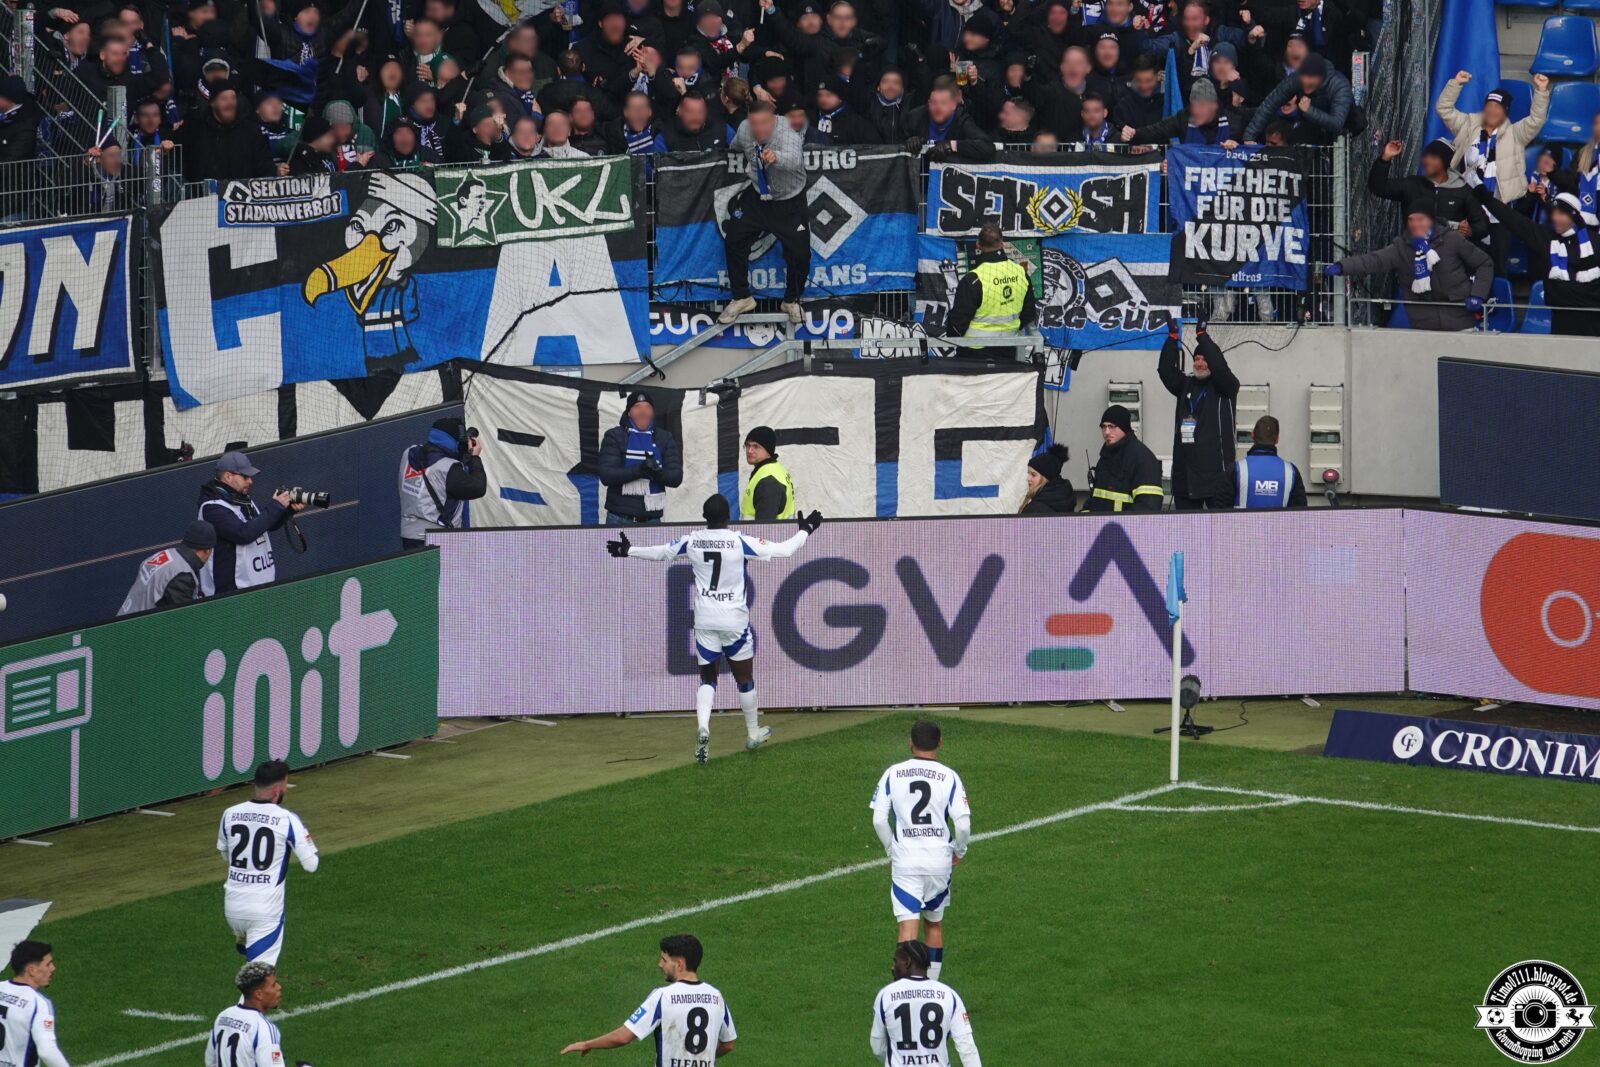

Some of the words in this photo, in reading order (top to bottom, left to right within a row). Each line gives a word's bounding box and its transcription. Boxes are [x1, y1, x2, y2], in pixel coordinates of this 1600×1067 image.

[728, 149, 858, 174] HURG
[251, 178, 312, 199] SEKTION
[1184, 166, 1302, 197] FREIHEIT
[226, 194, 341, 222] STADIONVERBOT
[1196, 191, 1245, 221] FÜR
[1250, 196, 1292, 223] DIE
[1184, 221, 1306, 265] KURVE
[993, 275, 1018, 286] Ordner
[1098, 300, 1172, 333] SÜD
[692, 539, 726, 549] HAMBURGER
[726, 540, 735, 549] SV
[703, 551, 722, 591] 7
[202, 577, 398, 781] init
[896, 768, 937, 780] HAMBURGER
[936, 773, 947, 782] SV
[909, 780, 932, 825] 2
[231, 812, 271, 824] HAMBURGER
[270, 816, 282, 826] SV
[230, 824, 276, 871] 20
[671, 993, 712, 1005] HAMBURGER
[890, 989, 935, 1002] HAMBURGER
[935, 990, 946, 1000] SV
[685, 1006, 709, 1055] 8
[894, 1002, 944, 1051] 18
[216, 1029, 240, 1067] 11
